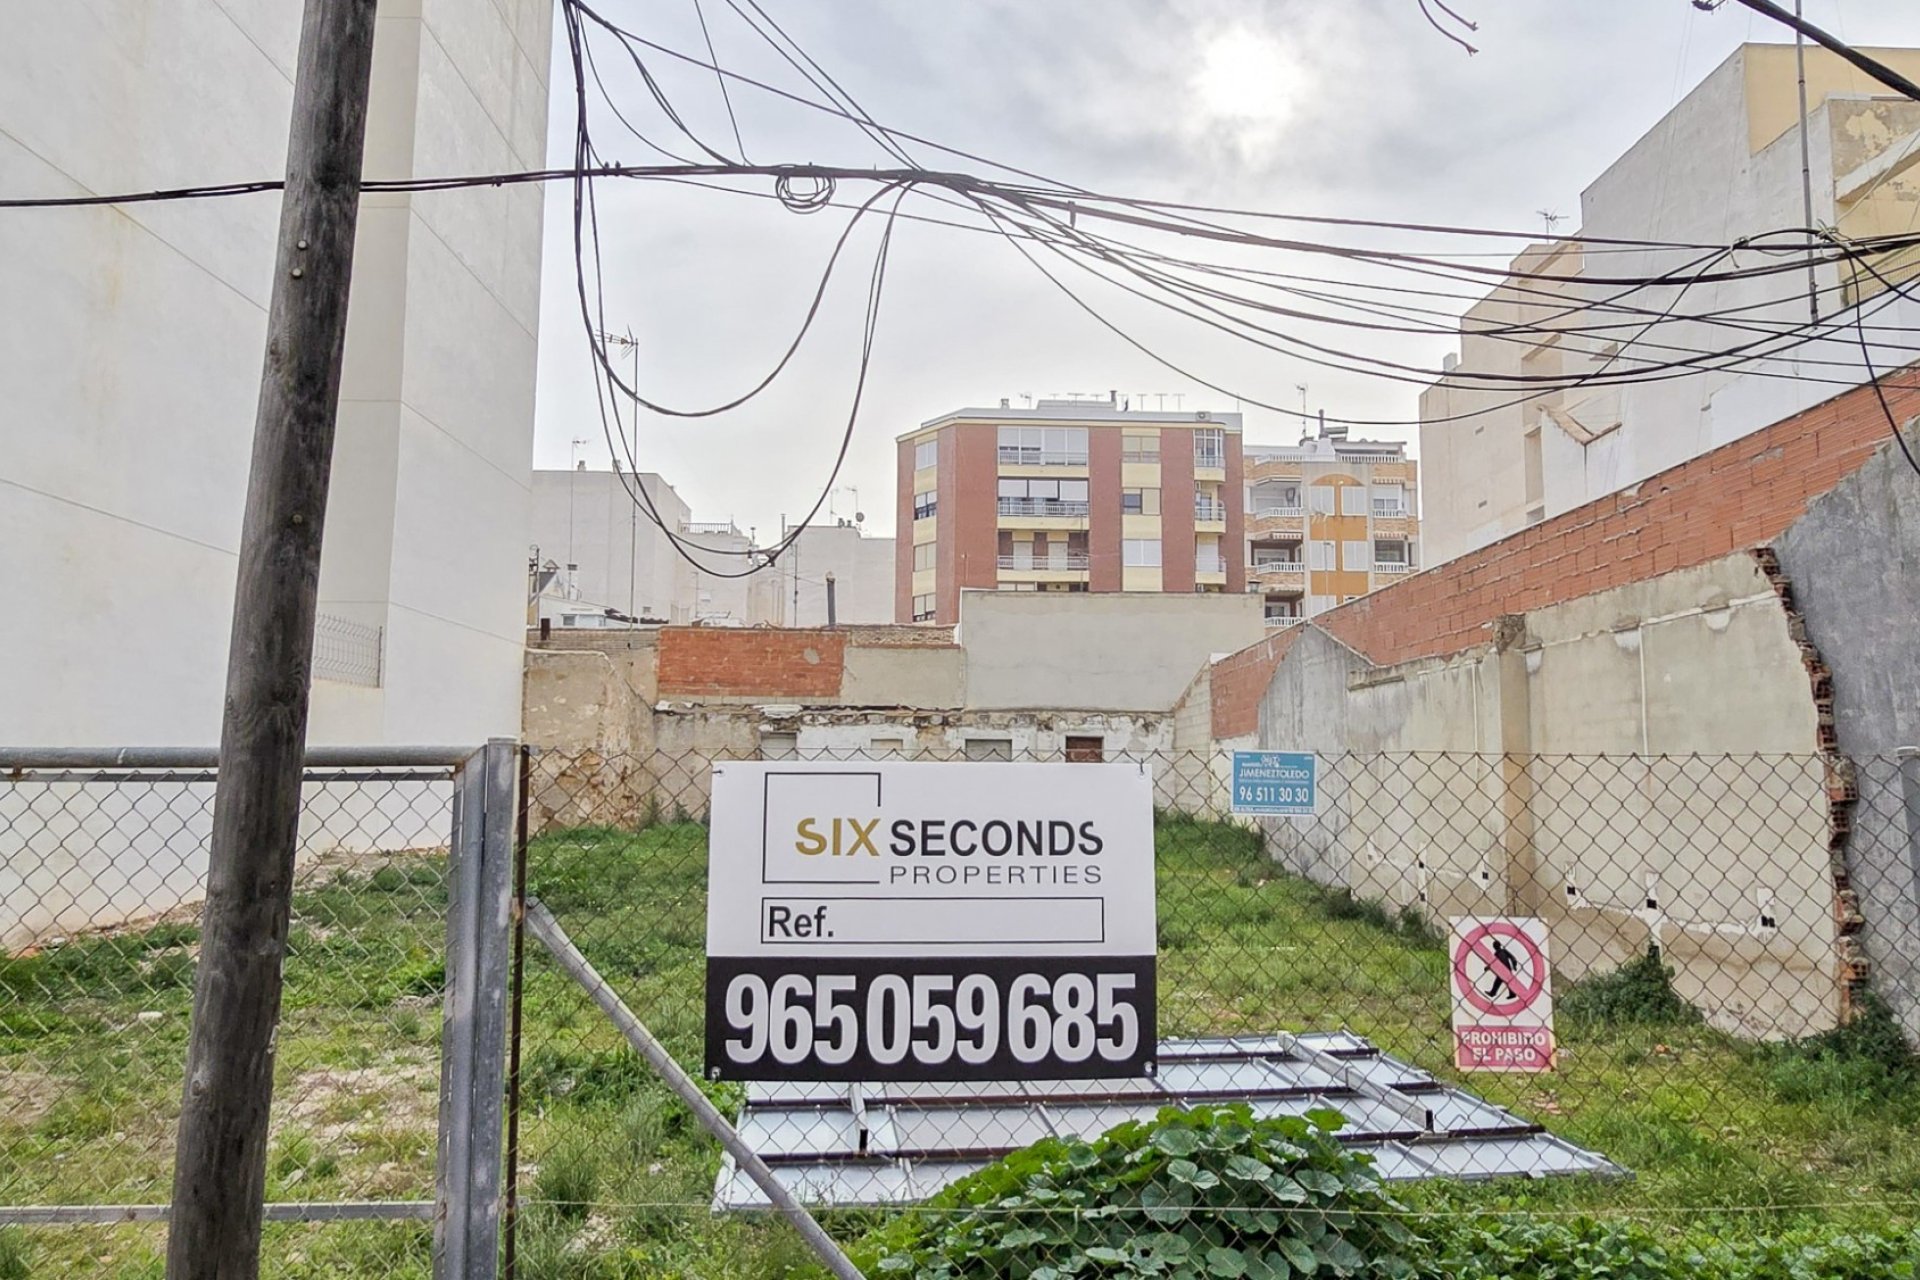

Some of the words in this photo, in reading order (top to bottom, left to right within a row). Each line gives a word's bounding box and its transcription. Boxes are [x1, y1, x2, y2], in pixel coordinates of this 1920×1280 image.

[1239, 785, 1253, 801] 96
[1256, 786, 1275, 802] 511
[1279, 787, 1293, 802] 30
[1295, 787, 1309, 803] 30
[795, 817, 881, 857] SIX
[889, 819, 1104, 857] SECONDS
[890, 865, 1103, 884] PROPERTIES
[768, 905, 835, 938] Ref.
[725, 973, 859, 1064] 965
[866, 973, 1000, 1064] 059
[1008, 972, 1139, 1064] 685
[1460, 1031, 1546, 1046] PROHIBIDO
[1472, 1047, 1491, 1061] EL
[1495, 1047, 1536, 1062] PASO
